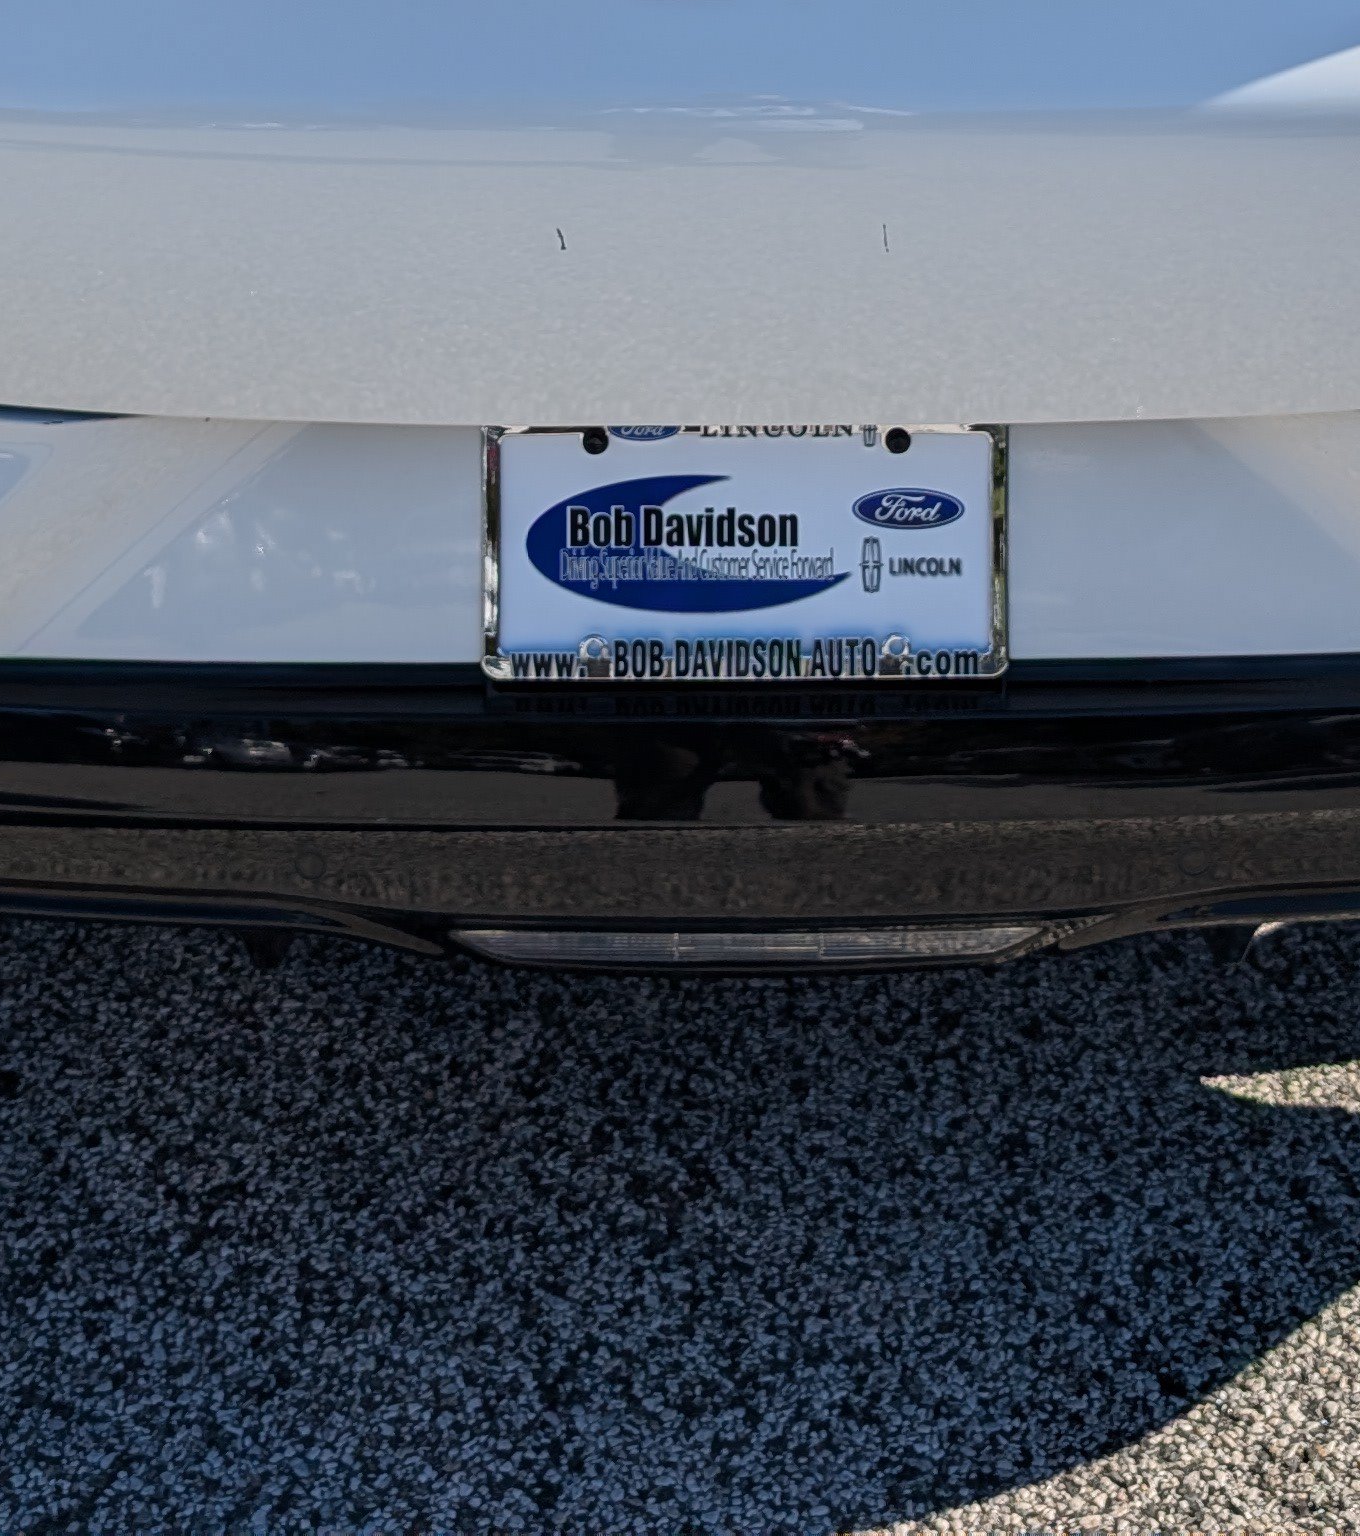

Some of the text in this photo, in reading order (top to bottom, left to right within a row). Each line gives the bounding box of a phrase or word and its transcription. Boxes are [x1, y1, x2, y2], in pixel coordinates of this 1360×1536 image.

[874, 493, 943, 522] Ford
[569, 507, 798, 547] Bob Davidson
[699, 548, 750, 580] Customer
[751, 548, 789, 580] Service
[790, 547, 835, 580] Forward
[888, 557, 962, 576] LINCOLN
[614, 639, 663, 678] BOB
[677, 638, 801, 678] DAVIDSON
[811, 638, 876, 677] AUTO
